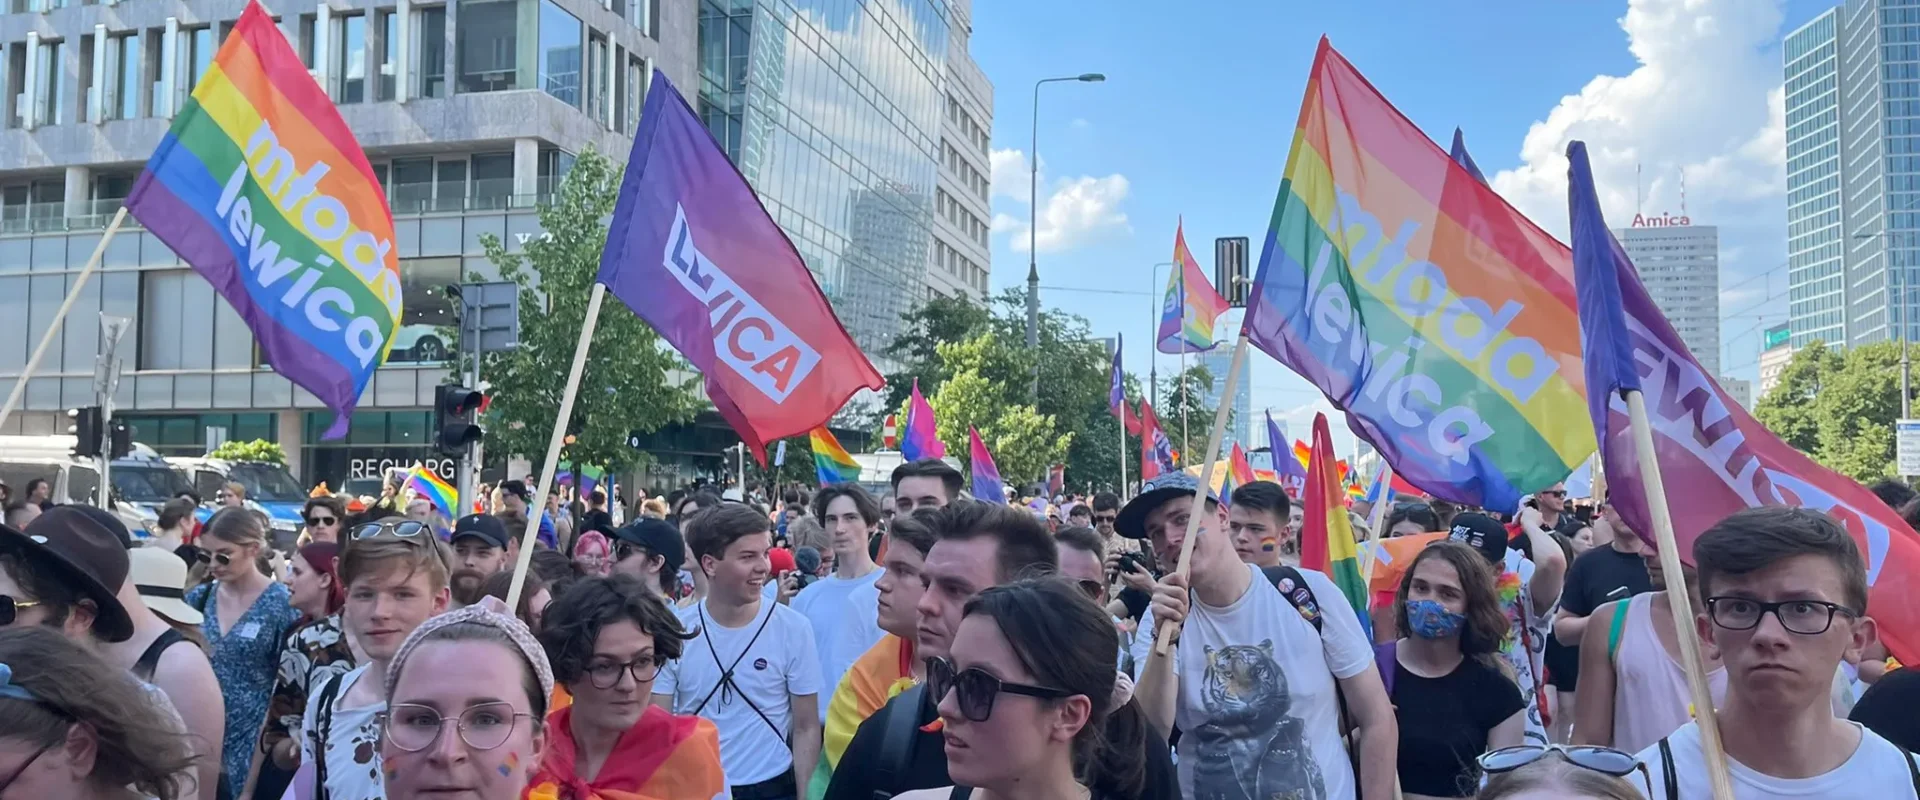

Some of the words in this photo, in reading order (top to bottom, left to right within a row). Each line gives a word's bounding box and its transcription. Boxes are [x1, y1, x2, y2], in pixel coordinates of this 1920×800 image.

[216, 161, 383, 368] lewica
[1632, 212, 1690, 227] Amica
[1305, 240, 1494, 465] lewica
